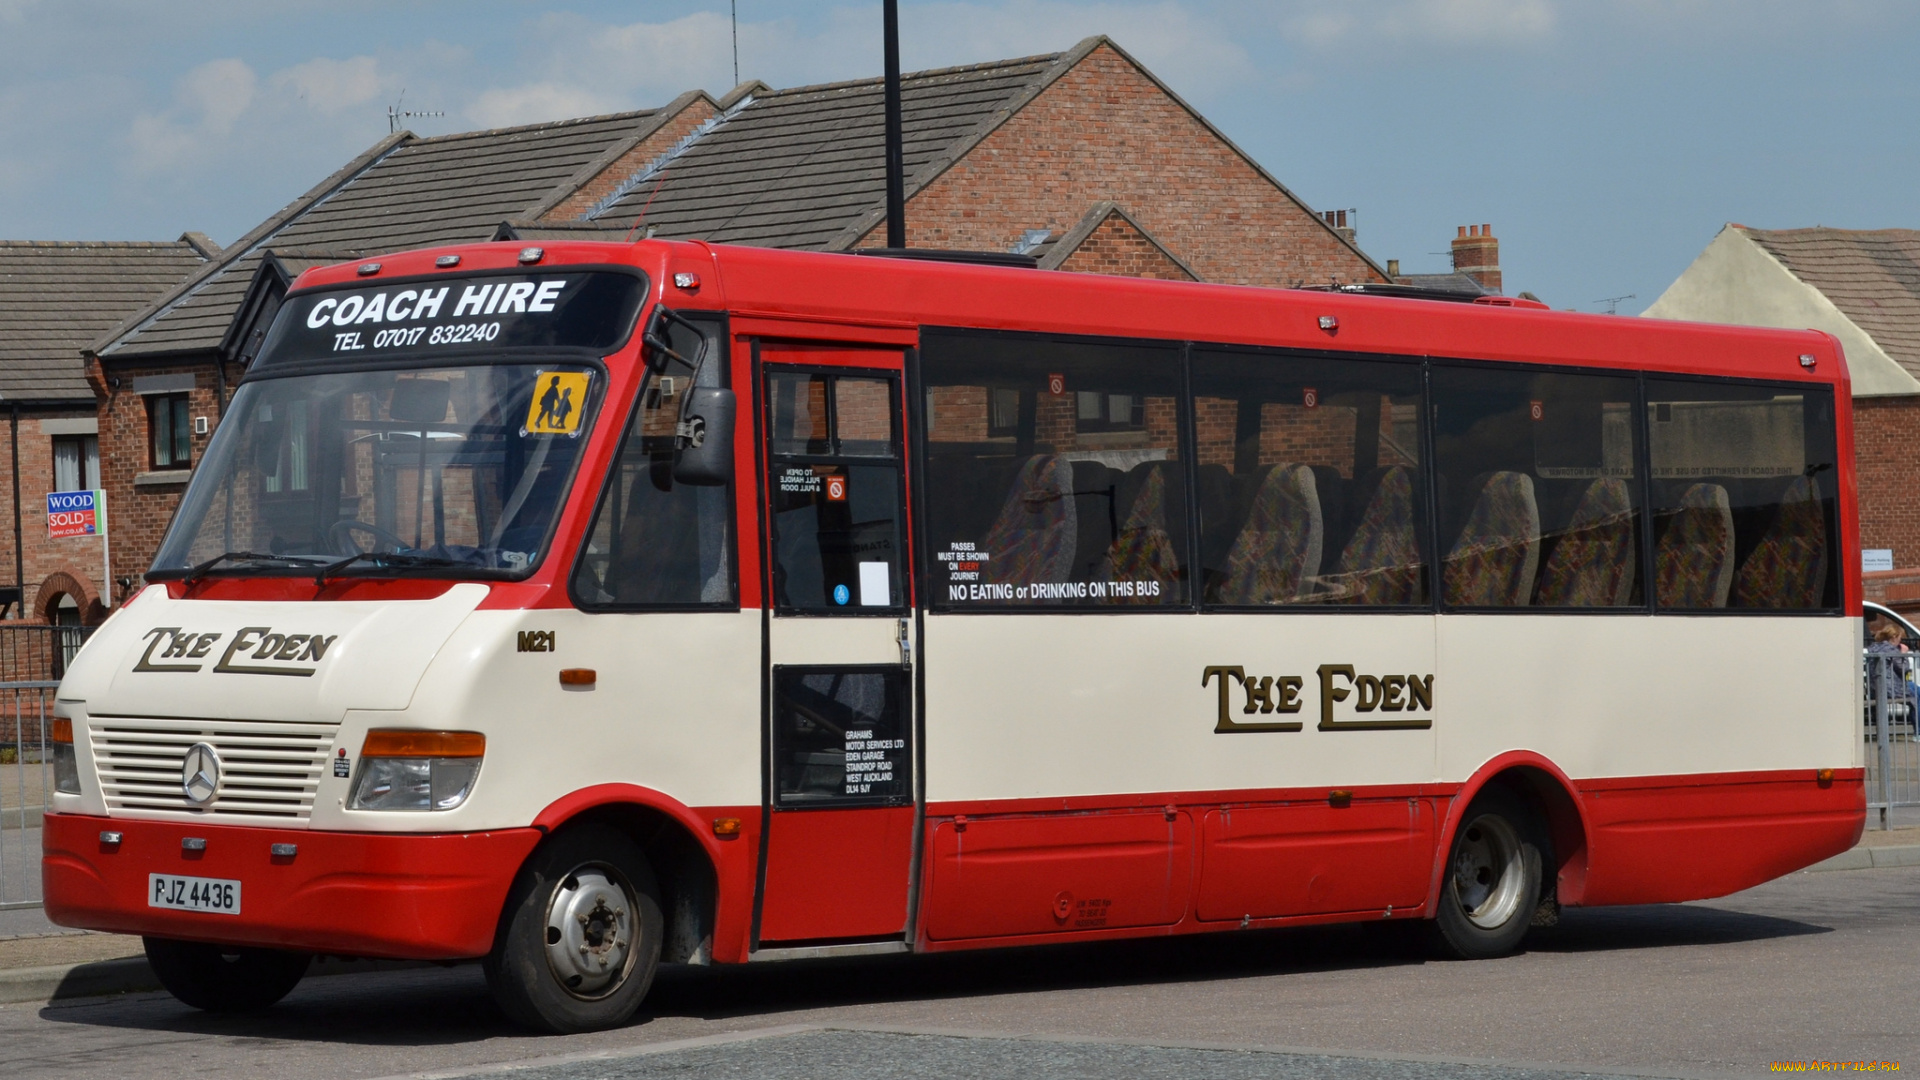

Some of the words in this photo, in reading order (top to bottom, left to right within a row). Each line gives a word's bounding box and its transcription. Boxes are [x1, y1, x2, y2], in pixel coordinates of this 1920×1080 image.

[307, 287, 450, 329] COACH
[453, 280, 567, 316] HIRE
[333, 332, 365, 352] TEL.
[373, 326, 426, 349] 07017
[428, 322, 500, 345] 832240
[49, 494, 94, 508] WOOD
[50, 512, 84, 527] SOLD
[951, 542, 975, 551] PASSES
[938, 552, 955, 561] MUST
[956, 552, 965, 561] BE
[966, 552, 989, 561] SHOWN
[949, 562, 958, 571] ON
[959, 562, 979, 571] EVERY
[950, 572, 979, 581] JOURNEY
[949, 584, 967, 600] NO
[970, 583, 1013, 600] EATING
[1016, 585, 1028, 599] or
[1030, 582, 1087, 599] DRINKING
[1089, 582, 1106, 597] ON
[1108, 581, 1134, 596] THIS
[1136, 580, 1160, 596] BUS
[517, 630, 555, 652] M21
[132, 627, 222, 673] THE
[213, 627, 338, 677] EDEN
[1202, 665, 1303, 734] THE
[1316, 664, 1434, 732] EDEN
[845, 730, 873, 740] GRAHAMS
[845, 741, 865, 750] MOTOR
[866, 740, 893, 750] SERVICES
[894, 739, 905, 748] LTD
[845, 752, 861, 761] EDEN
[862, 751, 885, 760] GARAGE
[846, 762, 876, 772] STAINDROP
[877, 761, 893, 770] ROAD
[846, 773, 862, 783] WEST
[863, 772, 893, 782] AUCKLAND
[845, 785, 859, 794] DL14
[860, 784, 871, 793] 9JY
[155, 878, 186, 905] PJZ
[189, 881, 234, 909] 4436
